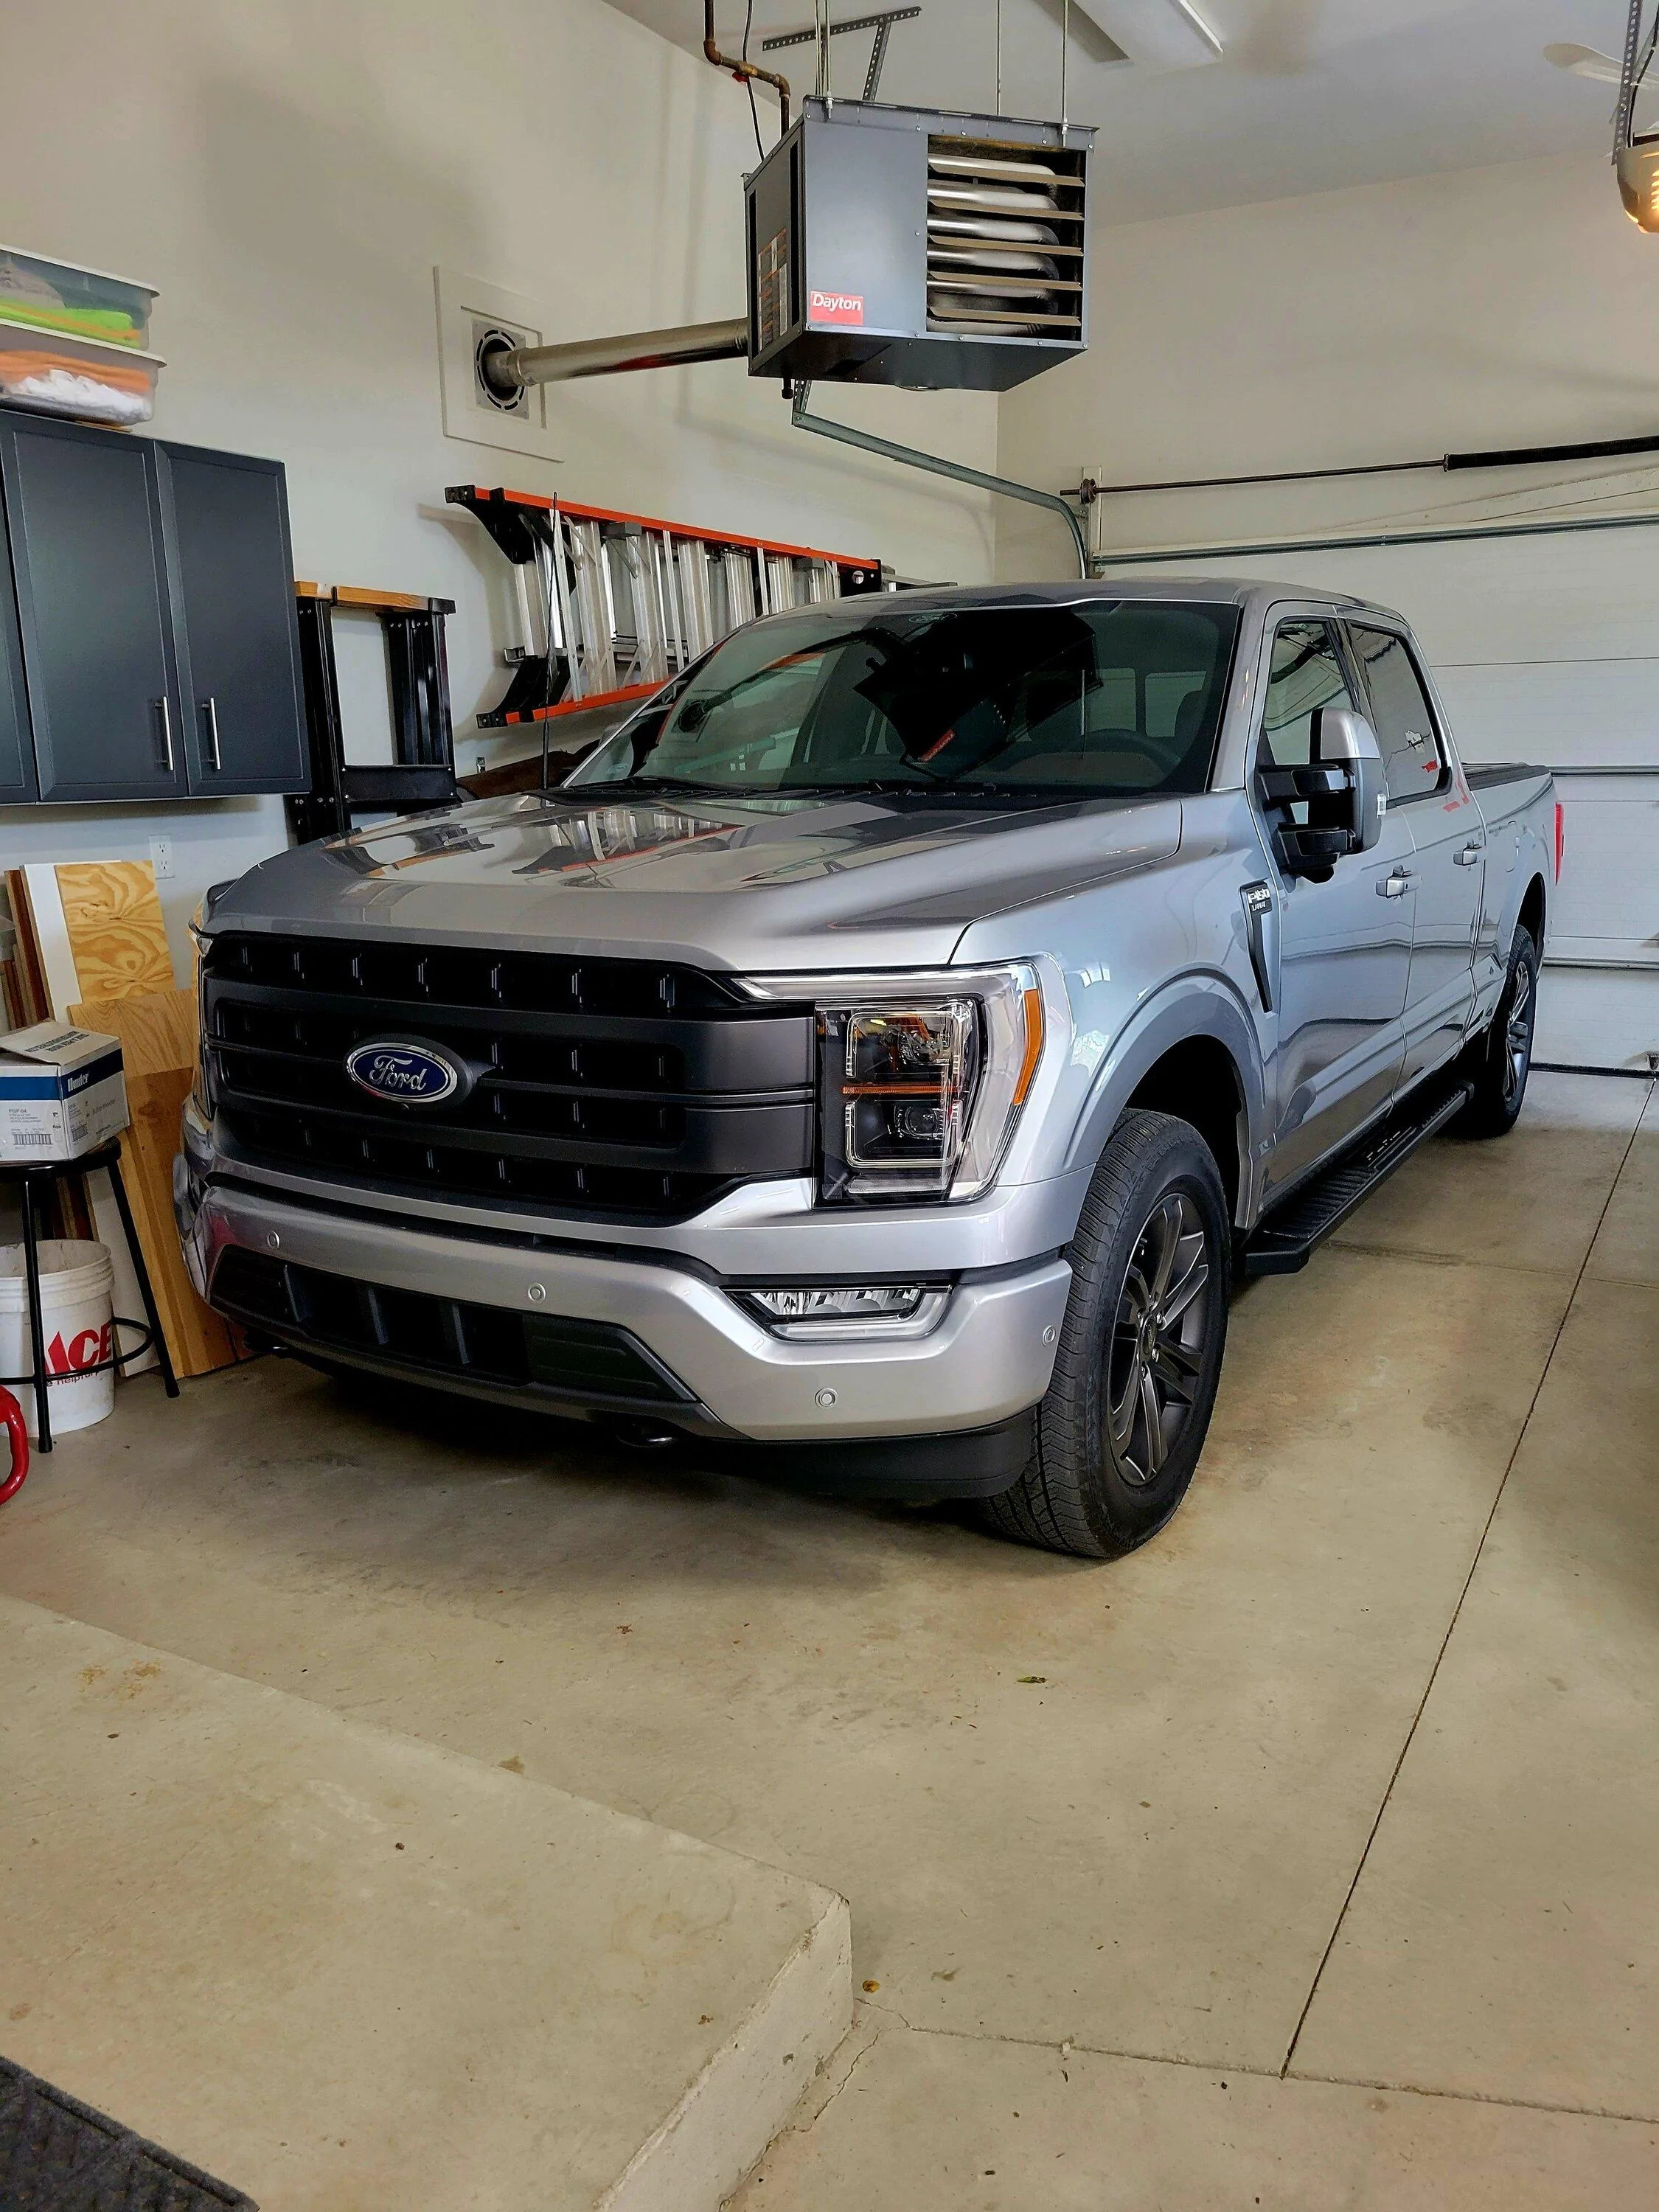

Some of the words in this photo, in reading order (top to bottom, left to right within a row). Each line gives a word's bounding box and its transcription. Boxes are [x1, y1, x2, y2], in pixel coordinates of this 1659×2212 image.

[813, 294, 861, 312] Dayton
[67, 1073, 89, 1092] Hunter
[369, 1054, 427, 1091] Ford
[44, 1319, 112, 1374] ACE
